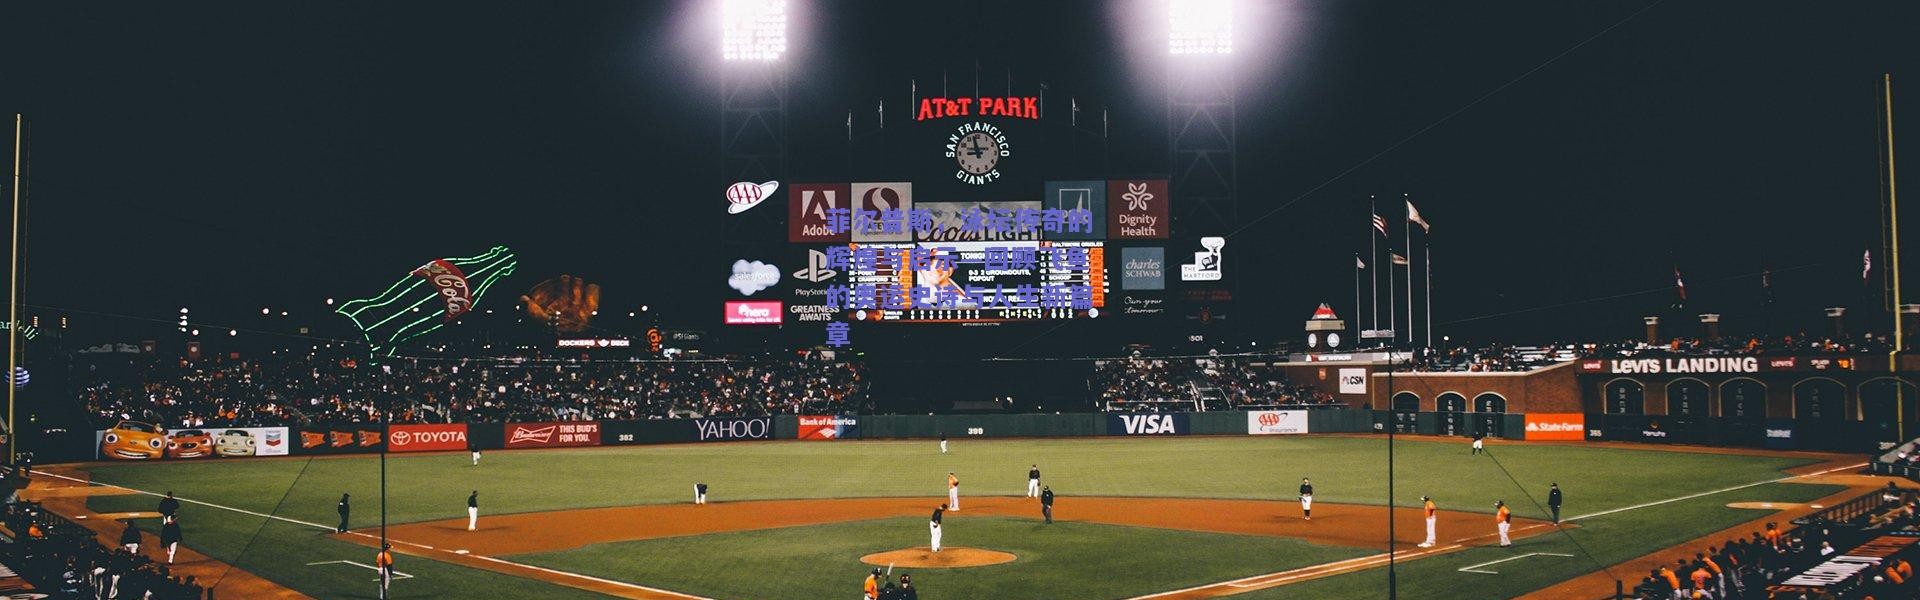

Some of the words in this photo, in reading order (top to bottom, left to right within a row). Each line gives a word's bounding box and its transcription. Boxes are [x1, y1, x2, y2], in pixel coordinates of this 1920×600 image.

[917, 96, 973, 121] AT&T
[978, 96, 1039, 120] PARK
[945, 134, 960, 158] SAN
[957, 121, 1010, 157] FRANCISCO
[956, 169, 1001, 185] GIANTS
[1119, 214, 1157, 227] Dignity
[1121, 227, 1156, 236] Health
[1126, 259, 1161, 270] charles
[1126, 269, 1162, 278] SCHWAB
[799, 313, 832, 321] AWAITS
[558, 339, 596, 347] DOCKERS
[610, 339, 630, 347] DECK
[1665, 357, 1759, 373] LANDING
[1350, 376, 1364, 385] CSN
[799, 418, 818, 426] Bank
[818, 418, 828, 426] of
[827, 418, 856, 426] America
[1118, 414, 1176, 434] VISA
[559, 424, 575, 433] THIS
[576, 424, 597, 433] BUD'S
[695, 418, 771, 441] YAHOO!
[413, 431, 467, 443] TOYOTA
[514, 429, 551, 439] Budweiser
[559, 434, 573, 443] FOR
[574, 434, 590, 443] YOU.
